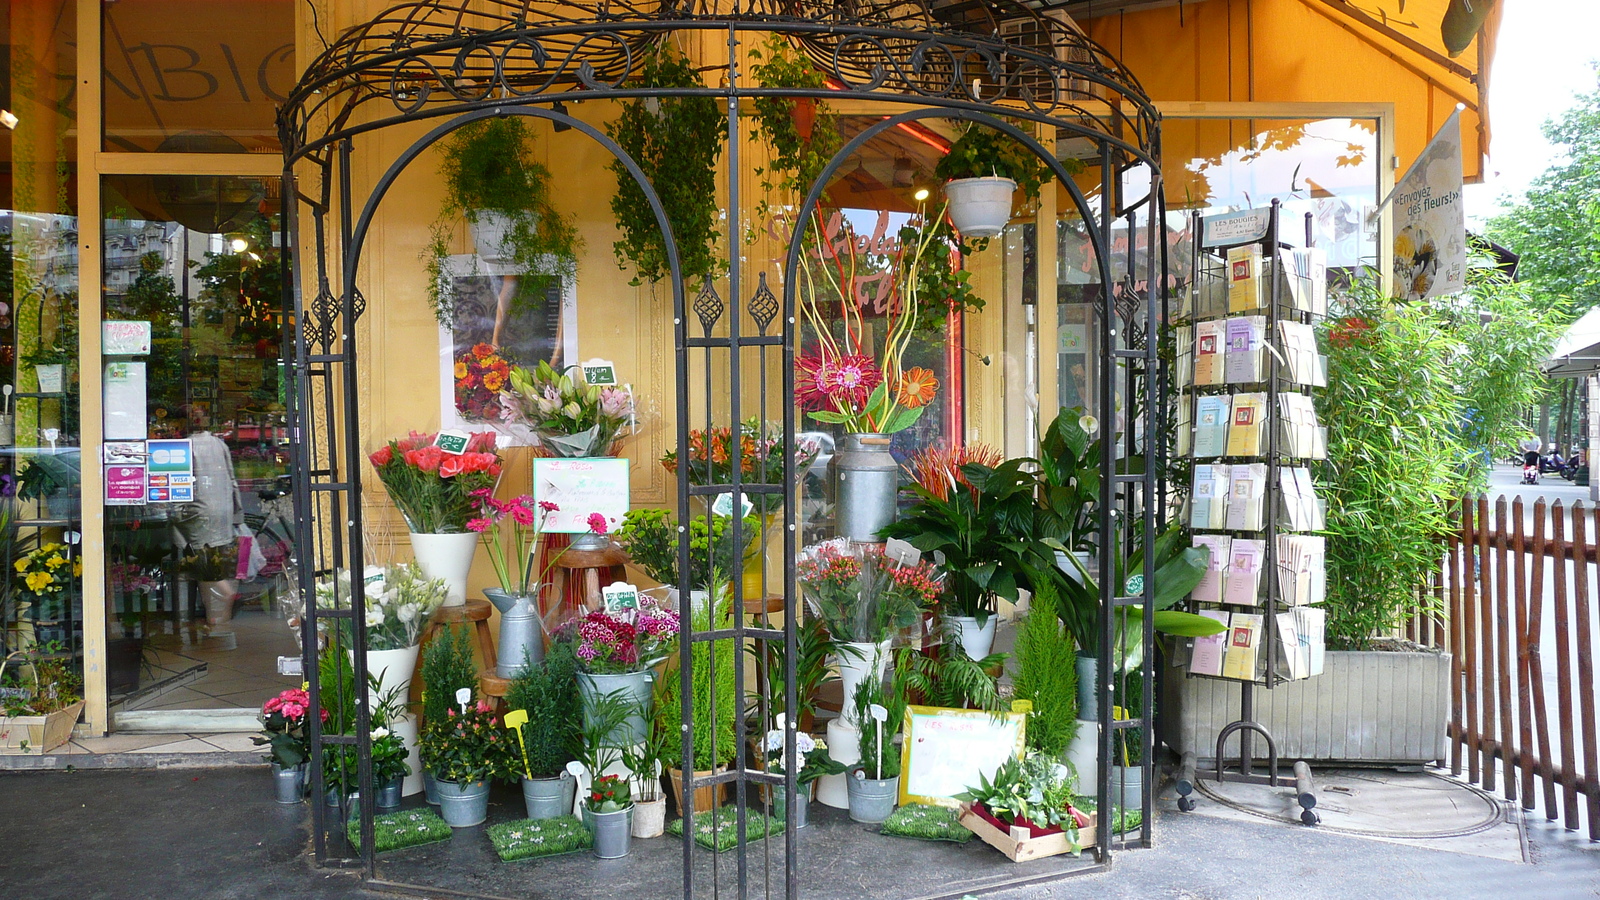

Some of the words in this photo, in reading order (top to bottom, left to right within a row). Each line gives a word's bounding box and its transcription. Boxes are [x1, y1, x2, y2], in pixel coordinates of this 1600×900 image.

[1408, 203, 1421, 216] des
[1229, 216, 1258, 225] BOUGIES
[152, 449, 186, 464] CB
